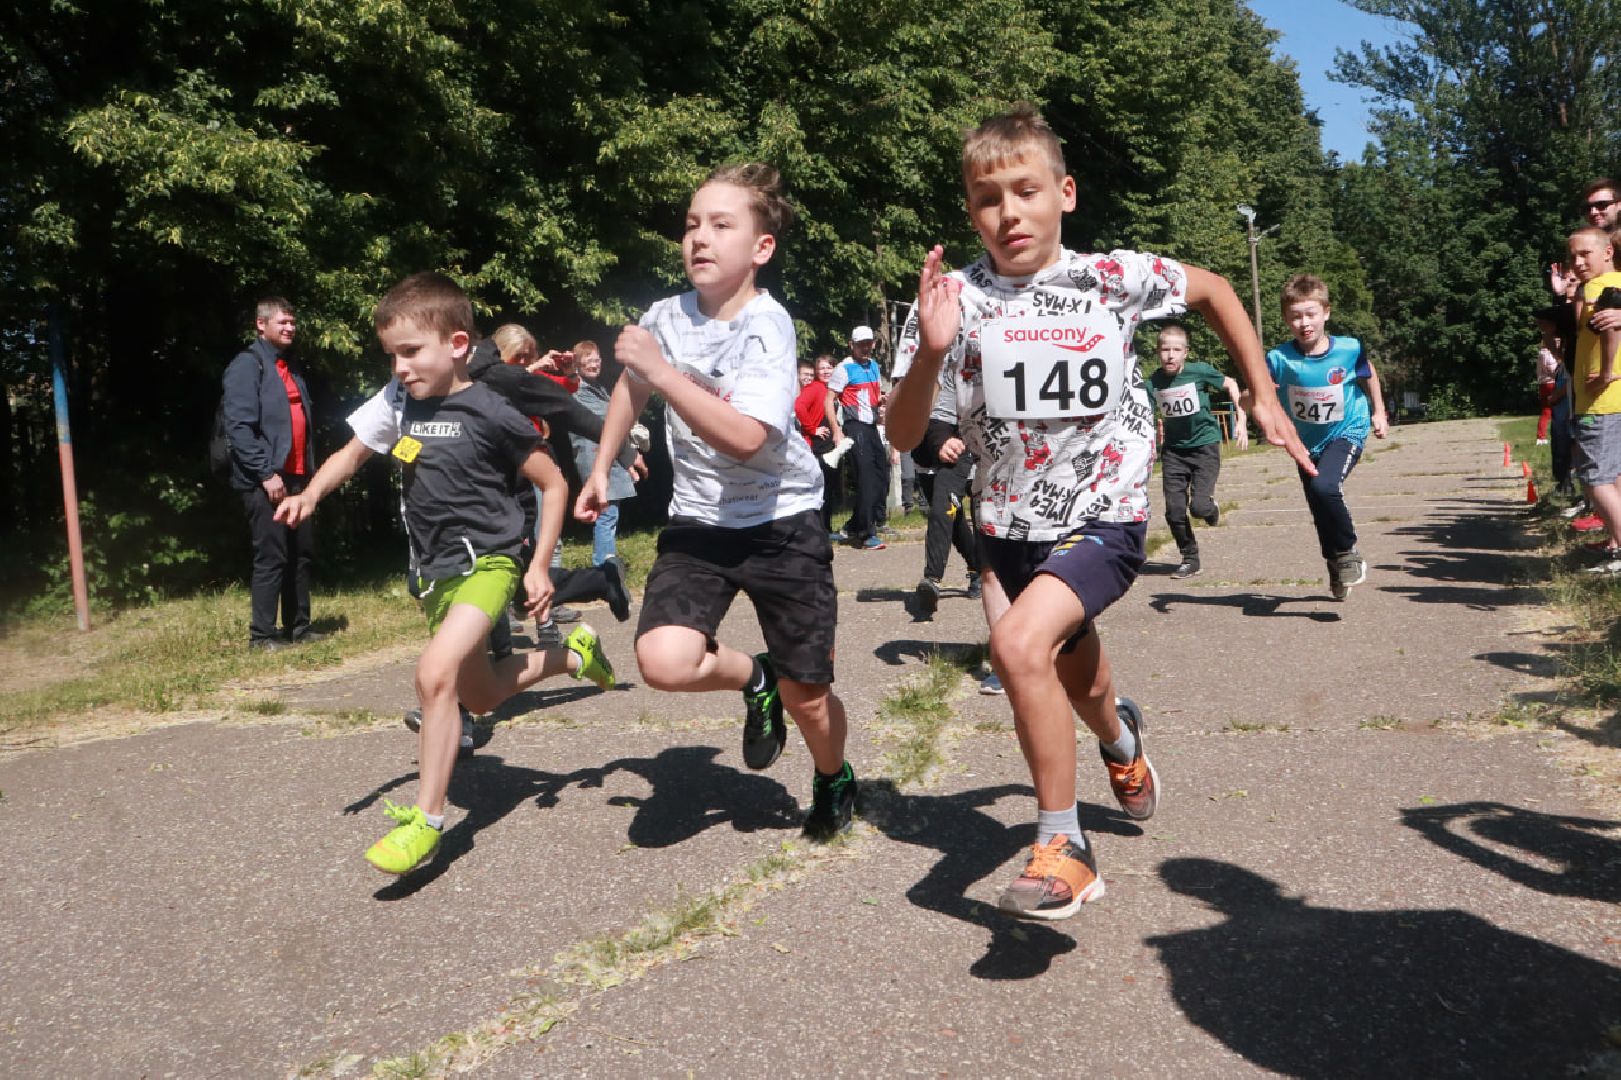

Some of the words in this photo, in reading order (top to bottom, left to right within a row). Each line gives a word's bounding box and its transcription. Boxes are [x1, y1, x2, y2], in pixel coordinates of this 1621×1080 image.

[1004, 327, 1087, 343] saucony
[1004, 358, 1109, 411] 148
[1163, 397, 1194, 416] 240
[1295, 401, 1337, 421] 247
